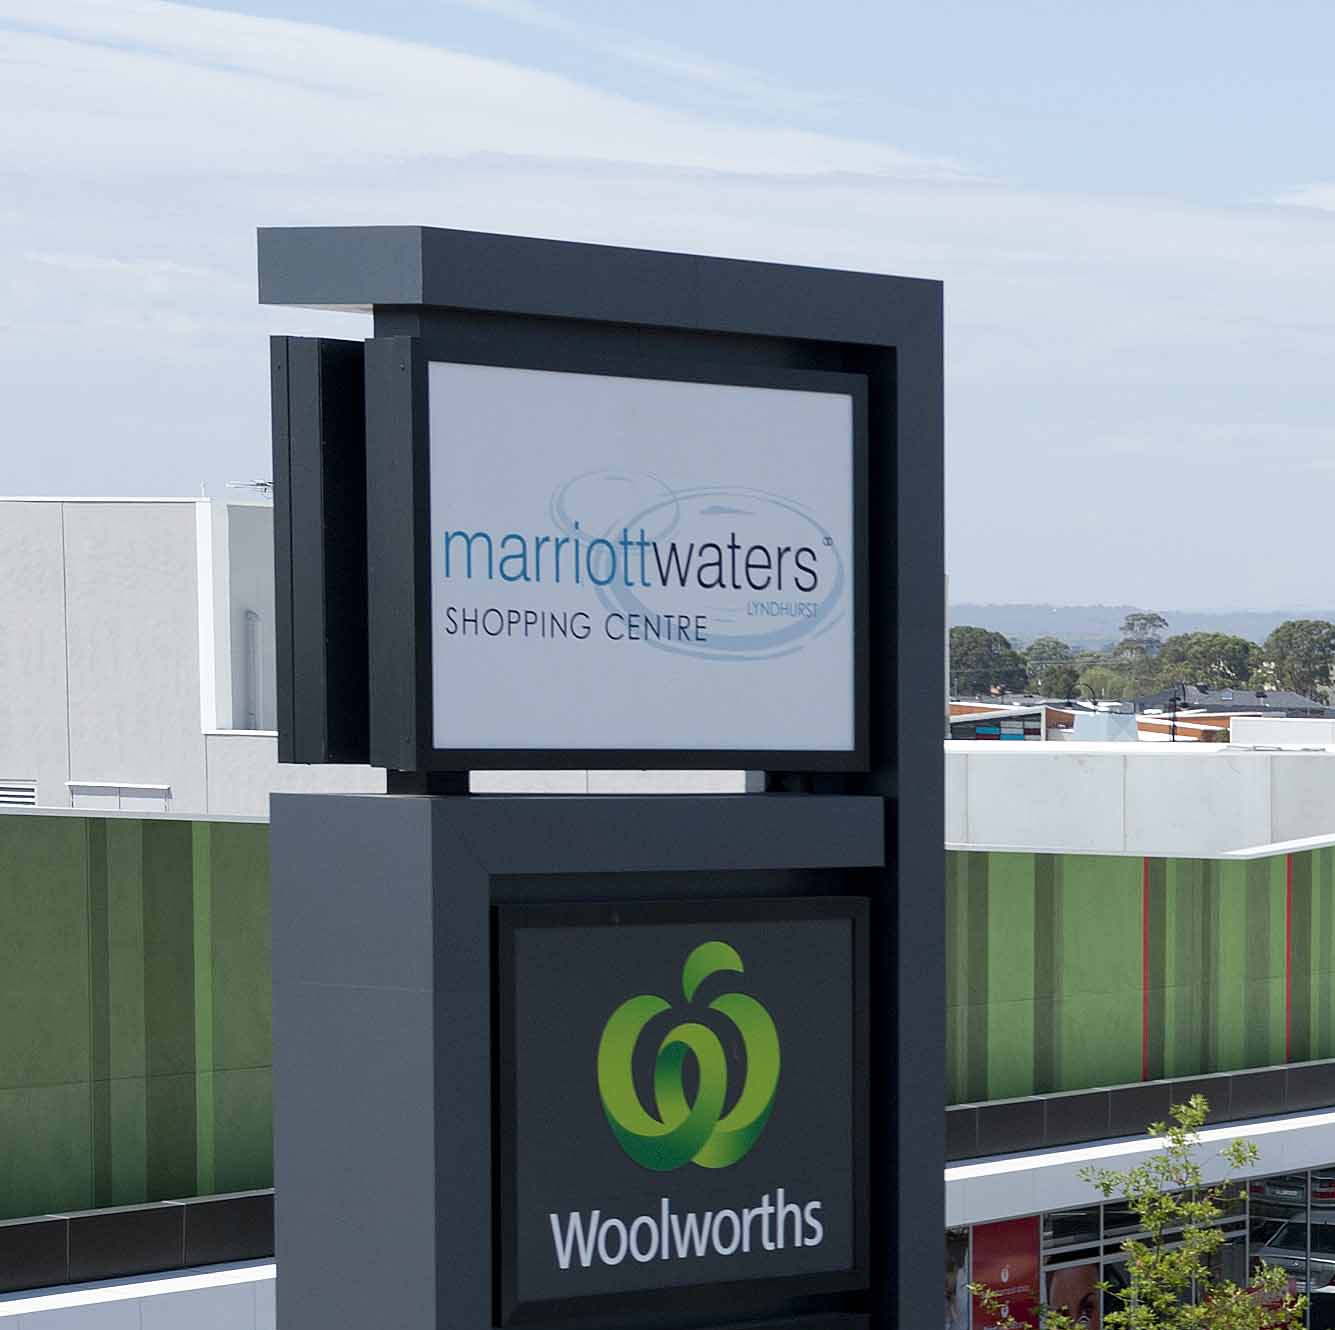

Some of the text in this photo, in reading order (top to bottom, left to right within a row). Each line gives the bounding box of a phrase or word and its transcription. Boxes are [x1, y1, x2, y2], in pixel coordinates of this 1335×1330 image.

[444, 522, 819, 593] marriottwaters
[446, 606, 708, 642] SHOPPING CENTRE
[746, 601, 818, 619] LYNDHURST
[550, 1187, 823, 1269] Woolworths
